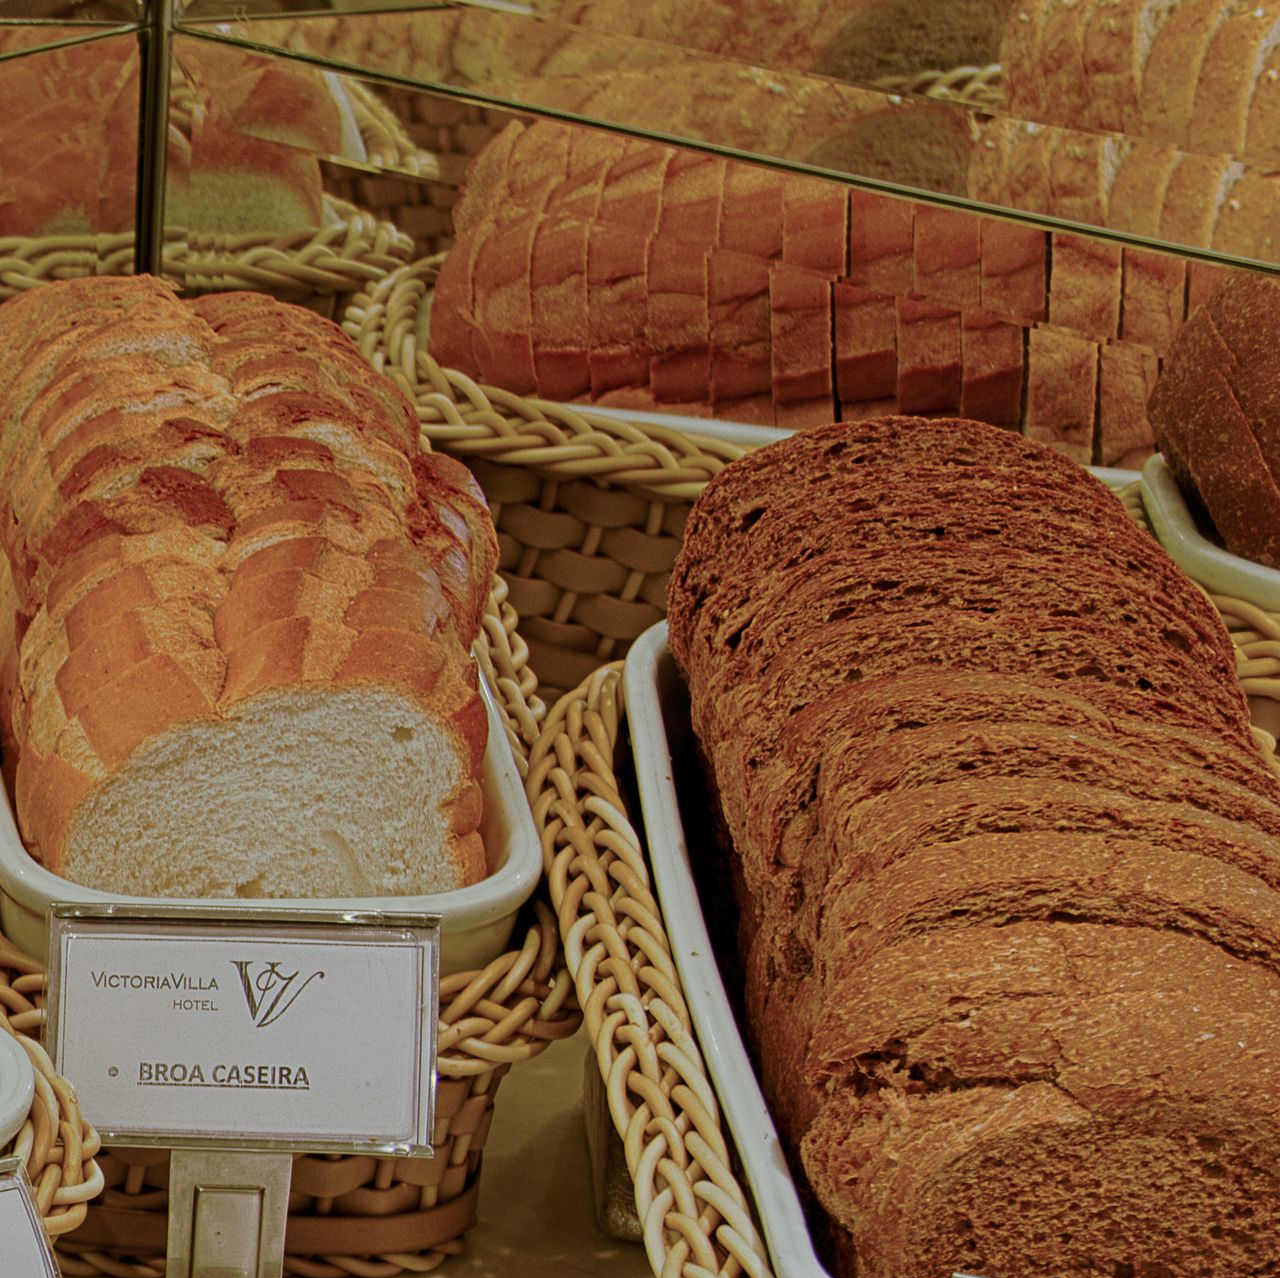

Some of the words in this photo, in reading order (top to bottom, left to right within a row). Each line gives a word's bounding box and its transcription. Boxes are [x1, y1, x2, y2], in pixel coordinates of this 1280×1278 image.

[172, 1000, 219, 1011] HOTEL
[139, 1063, 205, 1083] BROA
[212, 1065, 310, 1087] CASEIRA
